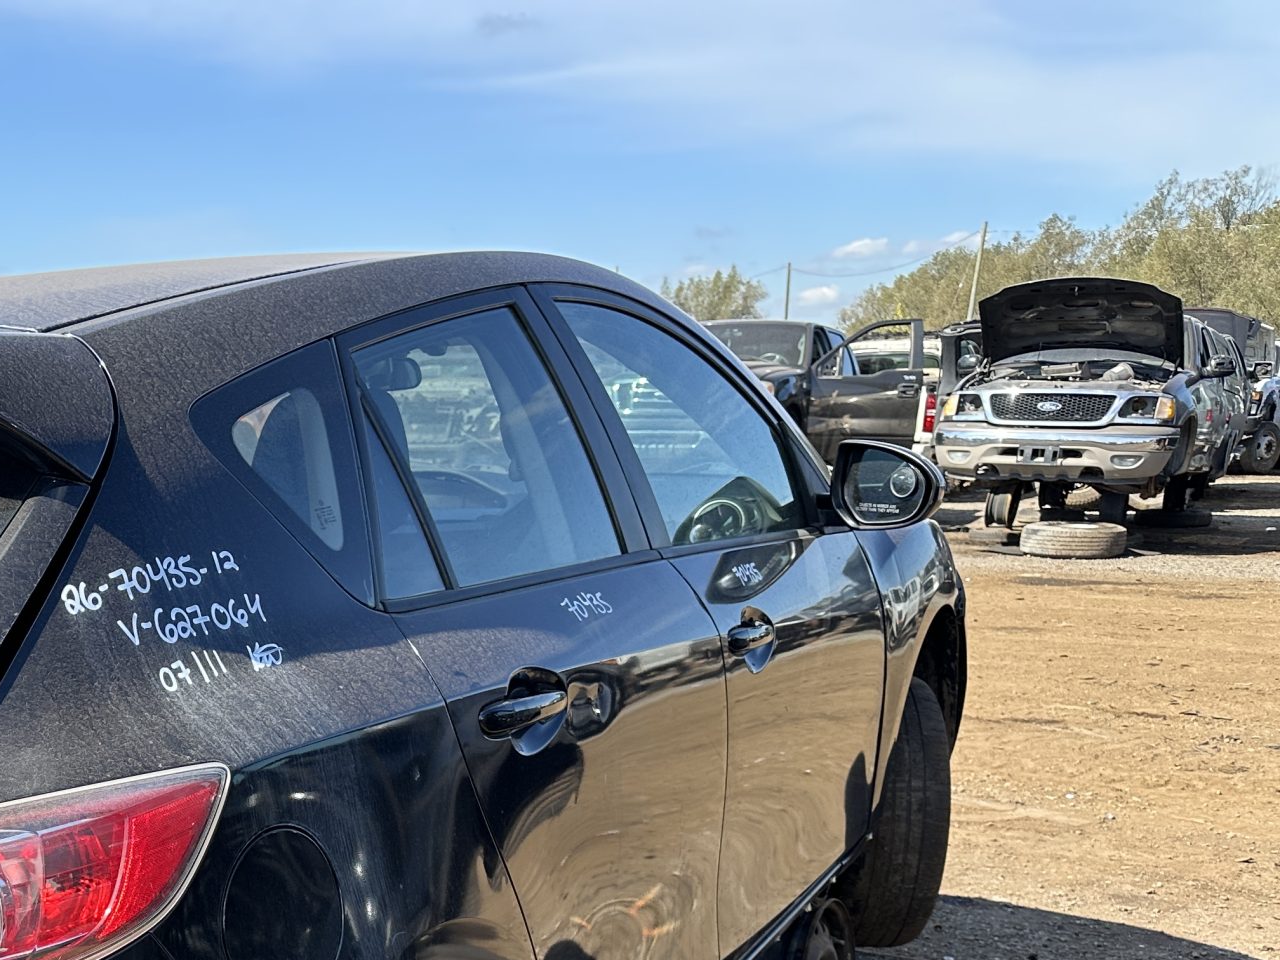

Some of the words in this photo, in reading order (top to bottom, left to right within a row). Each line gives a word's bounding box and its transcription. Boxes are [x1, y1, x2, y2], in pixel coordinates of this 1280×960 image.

[60, 550, 240, 615] 26-70435-12
[732, 562, 764, 587] 70435
[116, 593, 267, 646] V-627064
[560, 591, 613, 622] 70435
